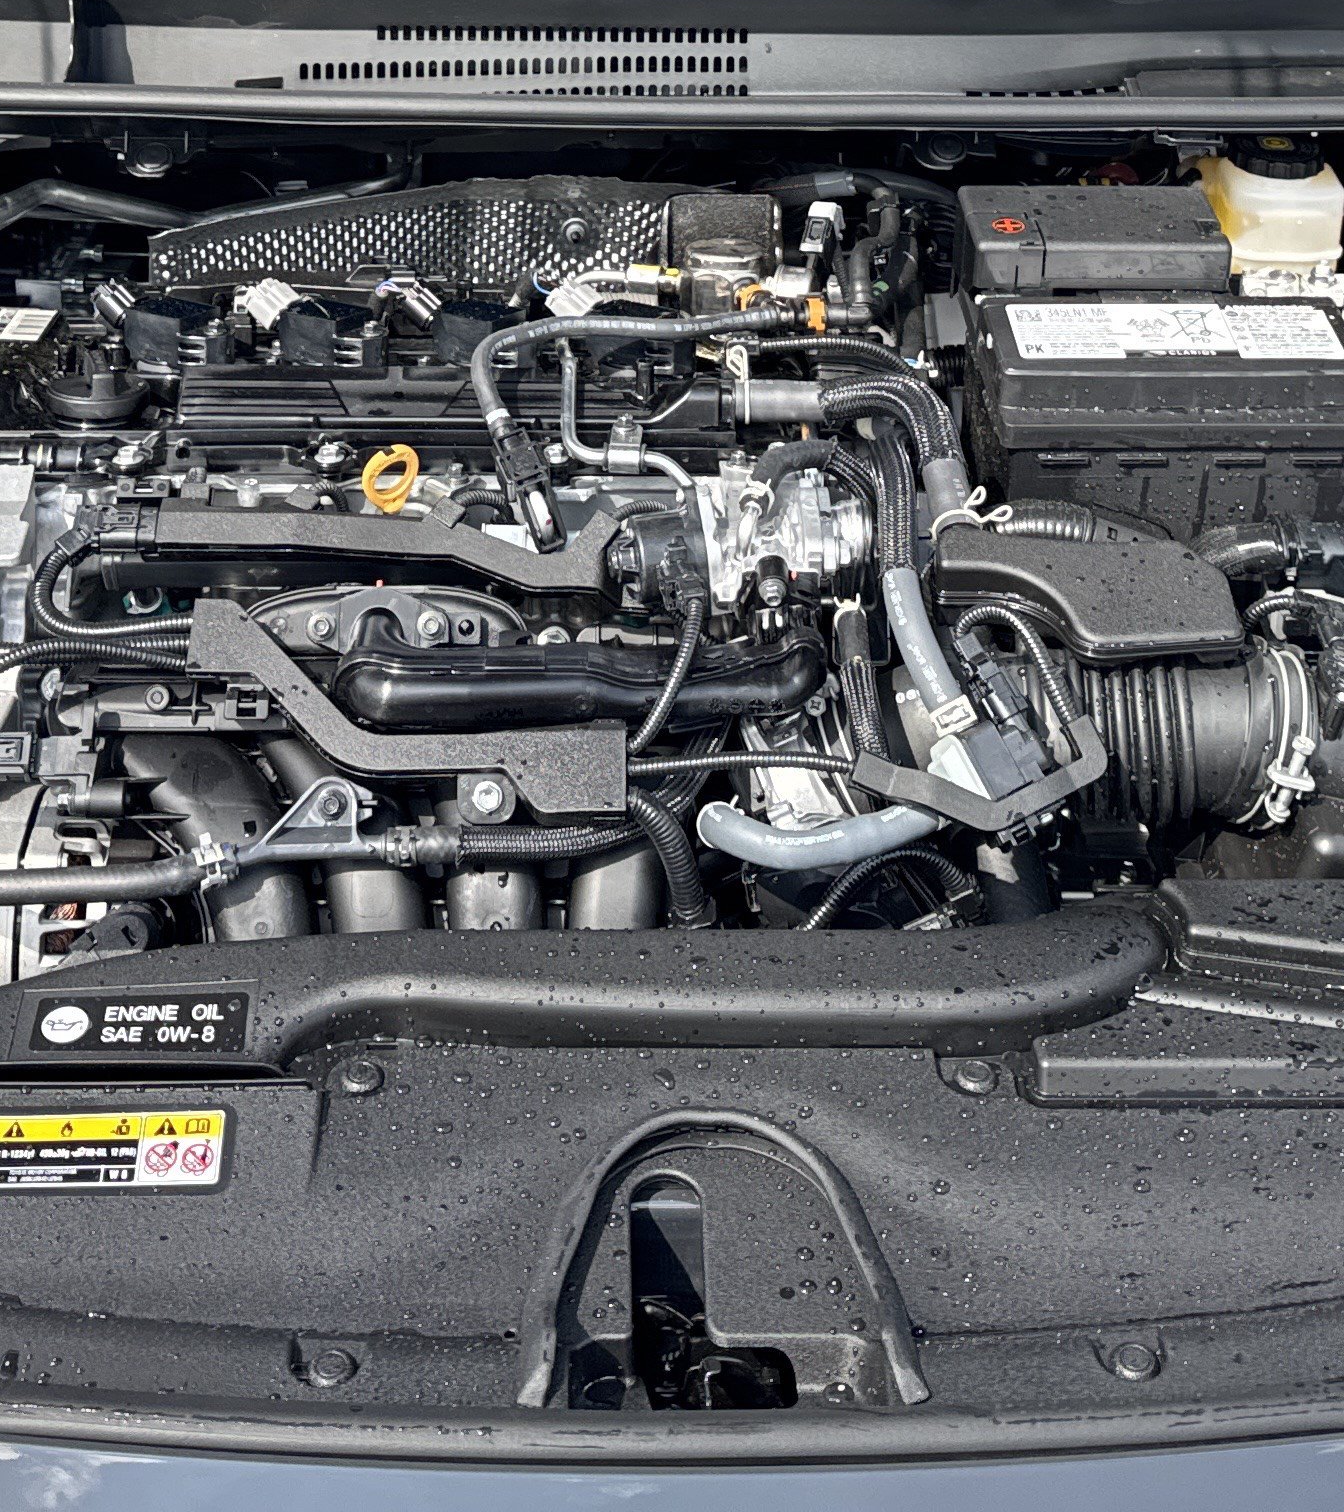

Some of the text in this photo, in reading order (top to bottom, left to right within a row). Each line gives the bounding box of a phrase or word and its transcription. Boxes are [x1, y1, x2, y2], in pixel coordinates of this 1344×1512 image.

[1024, 343, 1044, 354] PK
[104, 1003, 224, 1022] ENGINE OIL
[100, 1025, 216, 1043] SAE 0W-8
